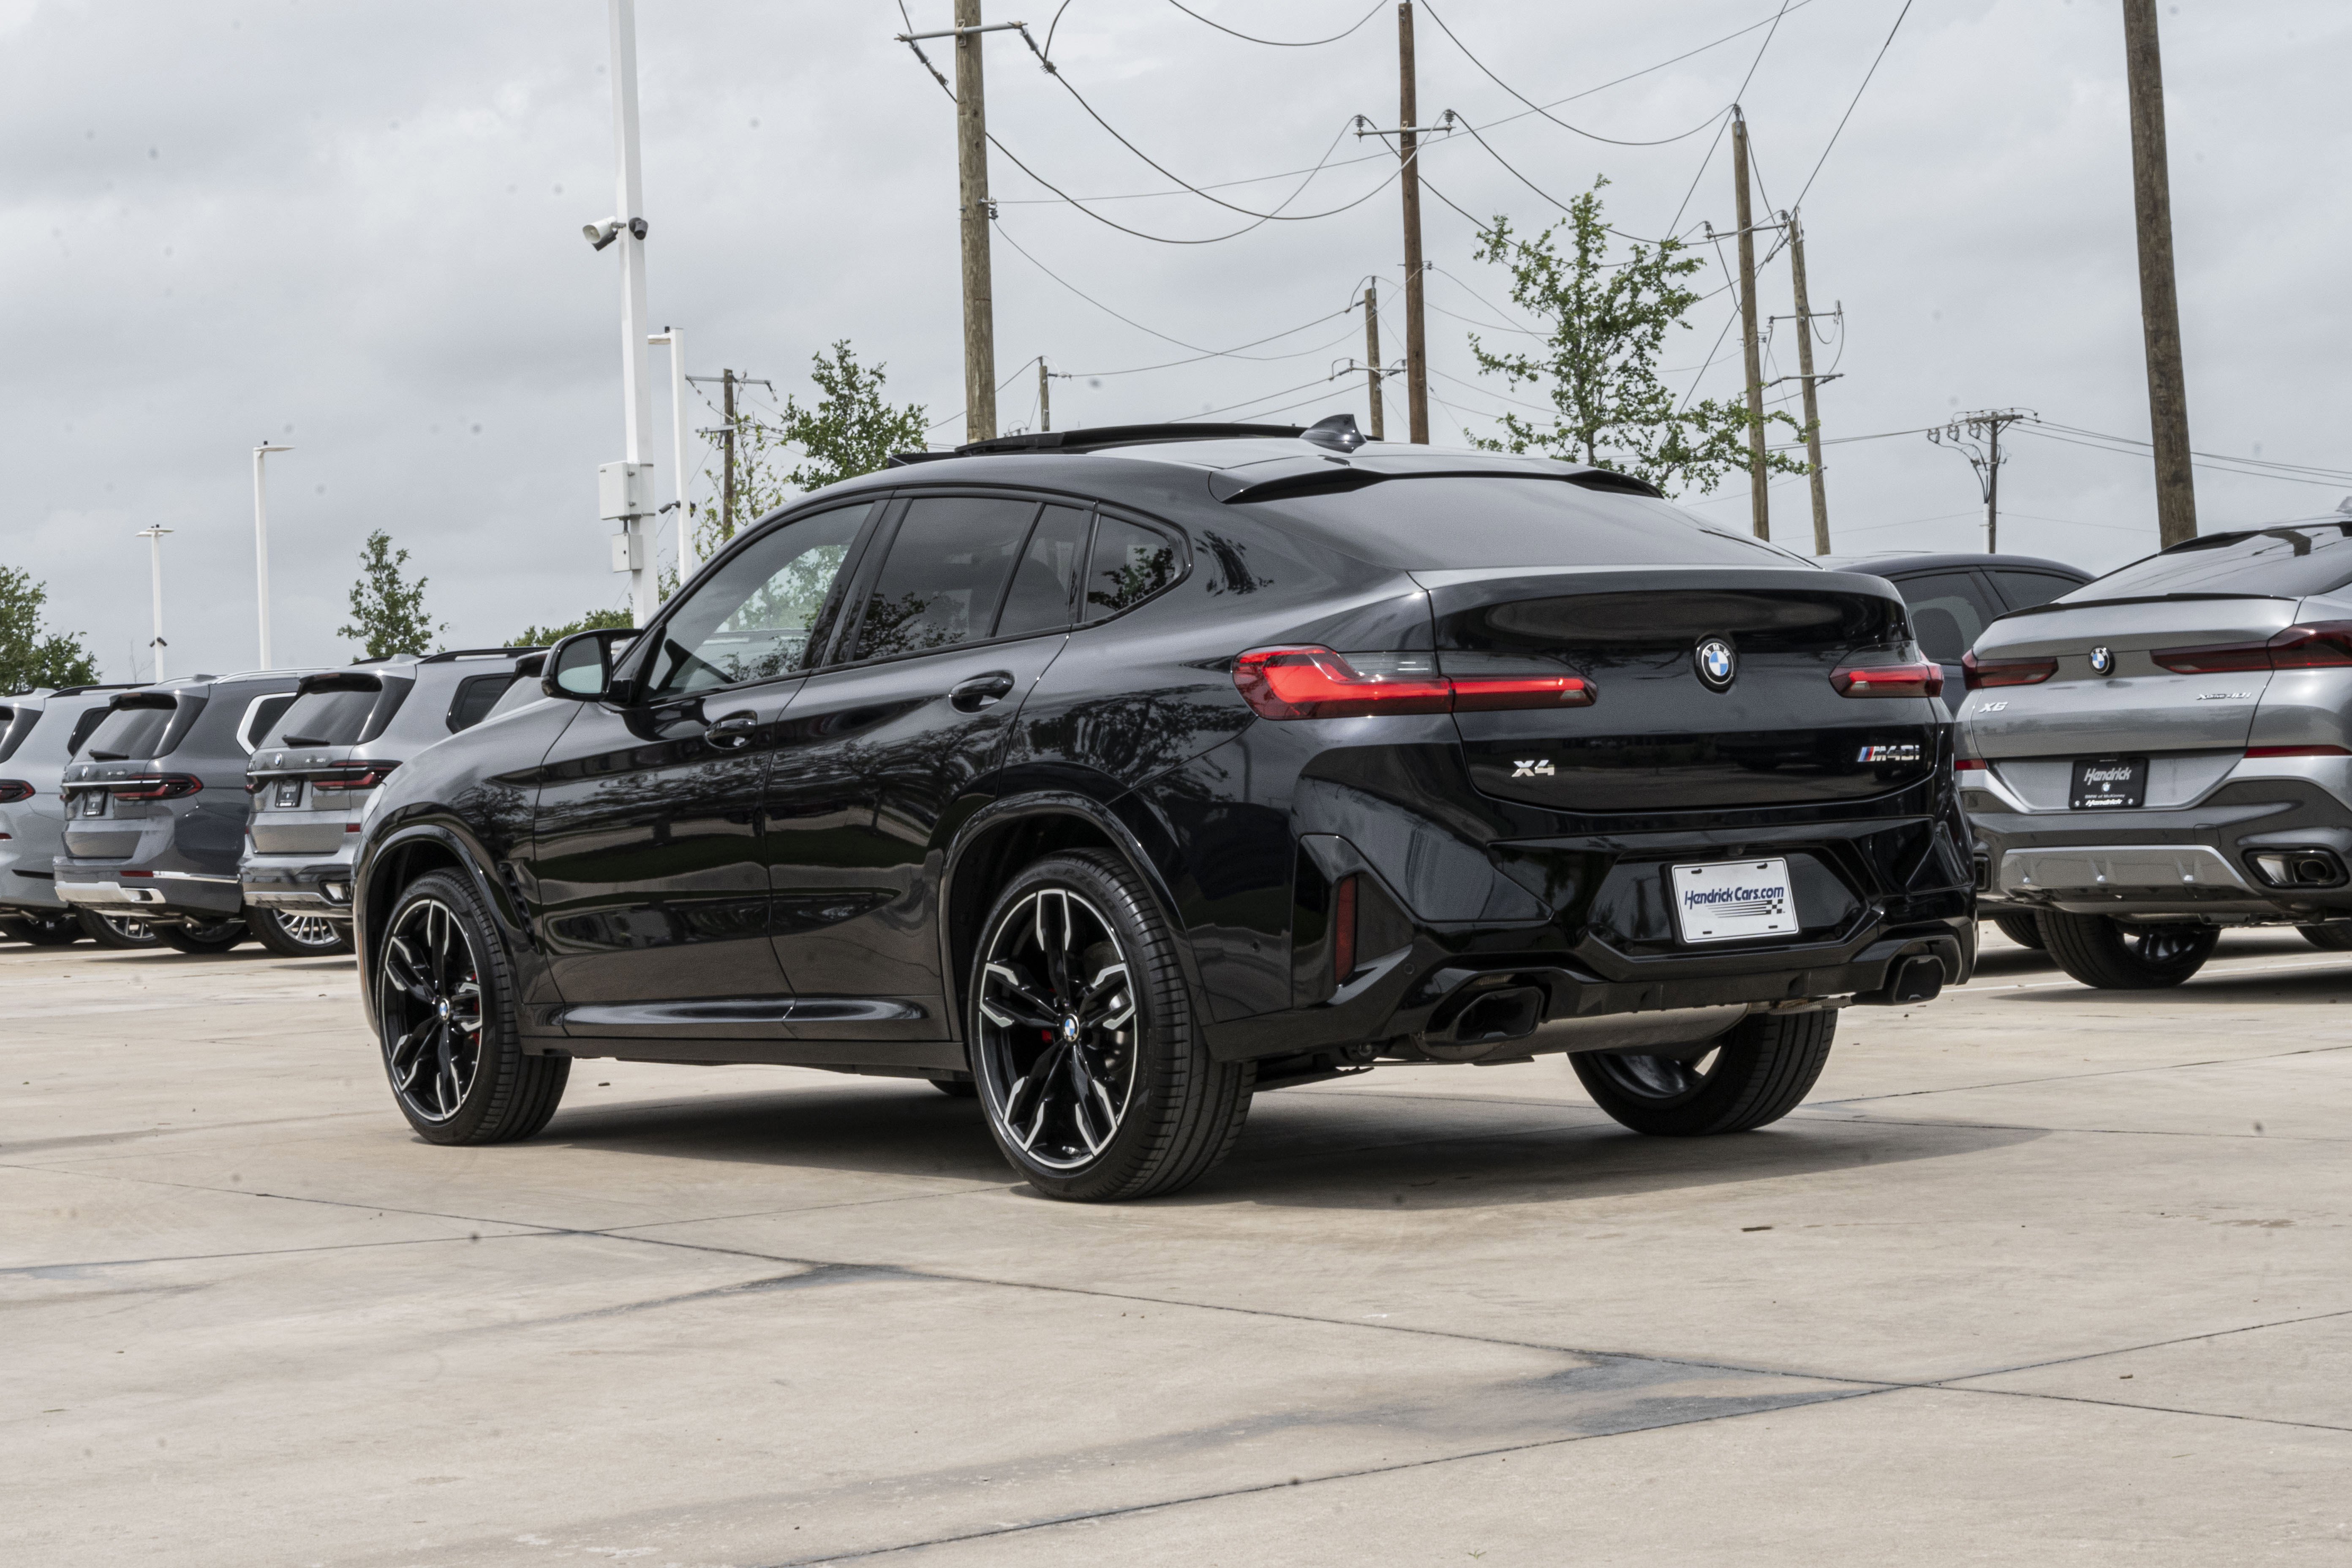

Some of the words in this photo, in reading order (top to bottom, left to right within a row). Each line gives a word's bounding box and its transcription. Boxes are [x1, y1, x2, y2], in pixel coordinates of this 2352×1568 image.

[1979, 701, 2008, 713] X6
[1511, 760, 1554, 777] X4
[2084, 767, 2132, 785] Hendrick
